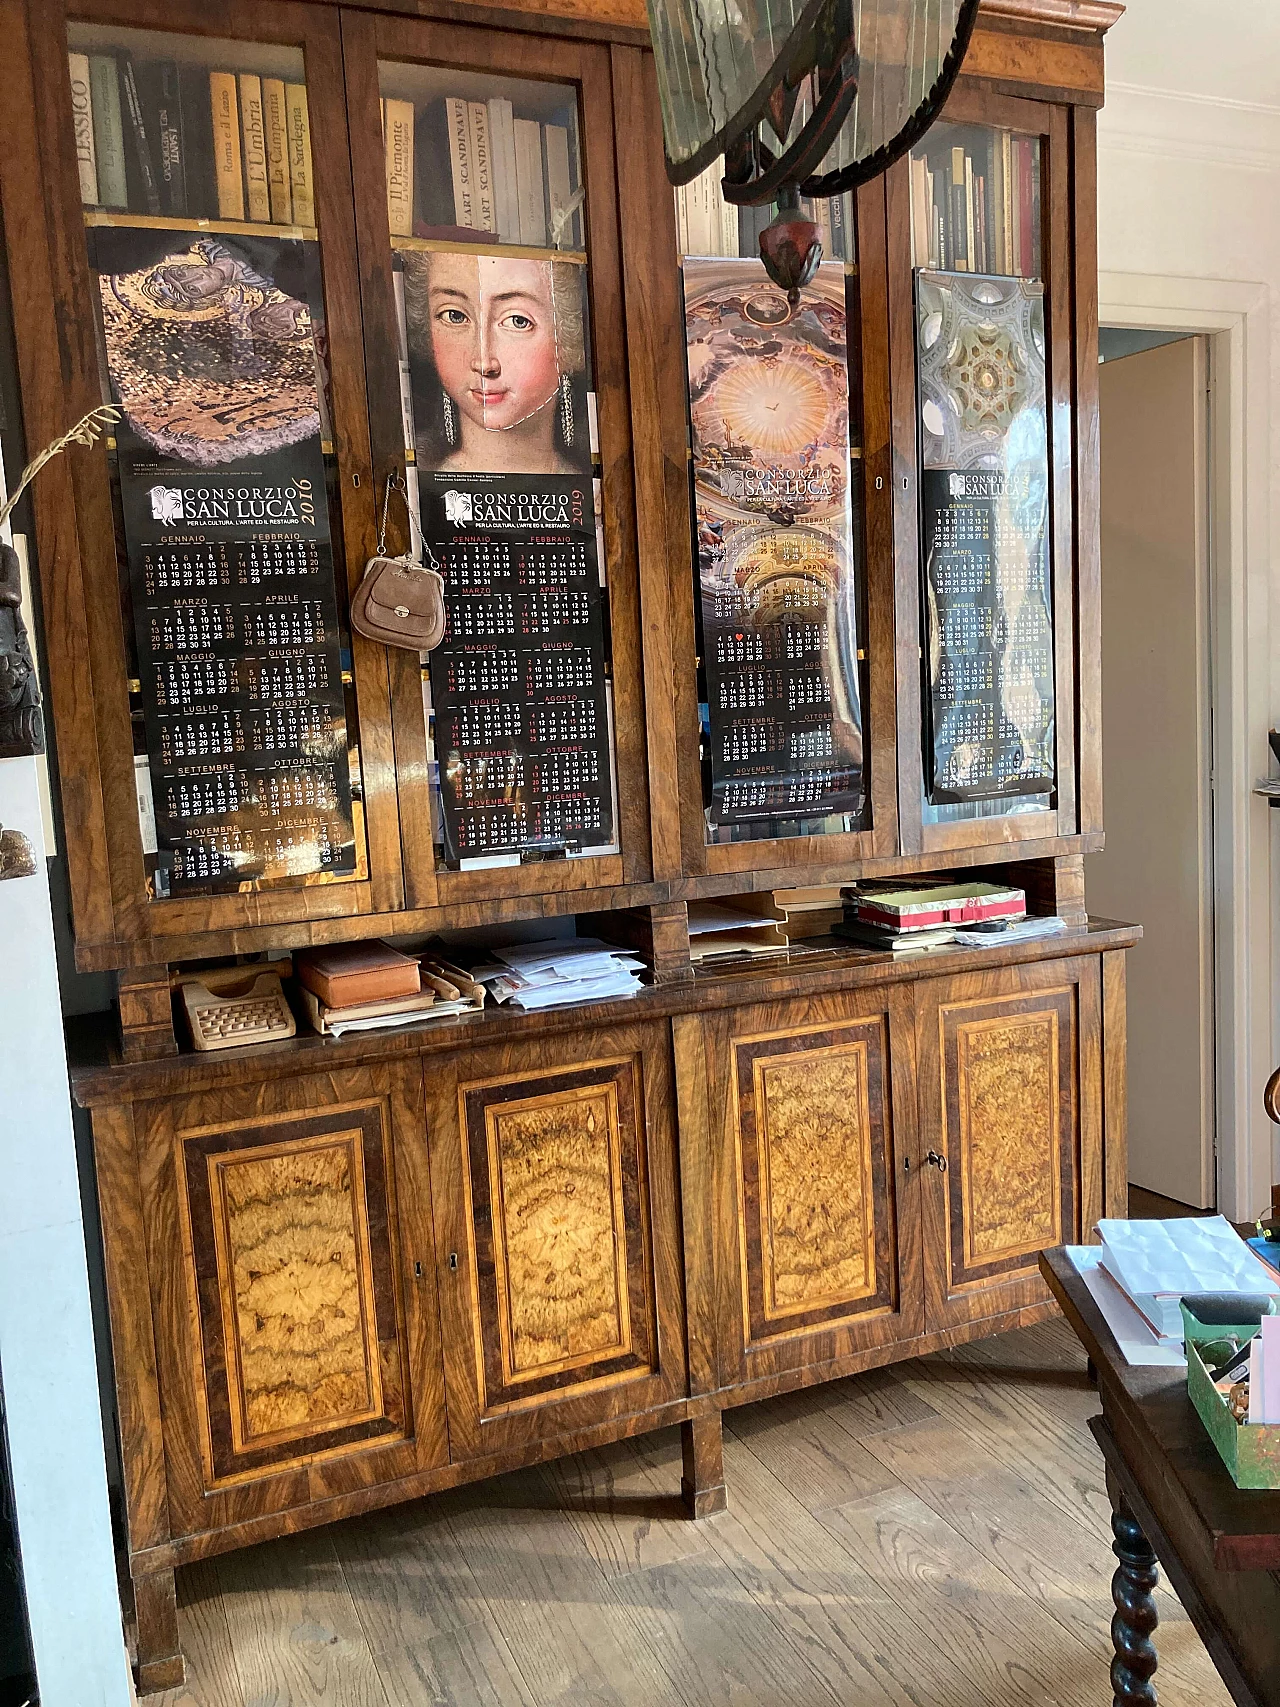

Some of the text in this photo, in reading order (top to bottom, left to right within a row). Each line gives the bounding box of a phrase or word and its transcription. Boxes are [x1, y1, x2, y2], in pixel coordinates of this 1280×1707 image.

[220, 90, 230, 118] Lazio
[71, 80, 92, 163] LESSICO
[220, 122, 231, 130] il
[245, 100, 265, 182] L'Umbria
[267, 93, 284, 185] La Campania
[169, 134, 180, 164] SANTI
[291, 107, 305, 187] La Sardegna
[161, 133, 172, 182] MEDIOEVO
[223, 142, 233, 173] Roma
[390, 120, 403, 201] Il Piemonte
[455, 102, 472, 227] L'ART SCANDINAVE
[475, 109, 491, 232] L'ART SCANDINAVE
[745, 470, 830, 480] CONSORZIO
[966, 475, 1019, 484] CONSORZIO
[184, 487, 297, 500] CONSORZIO
[746, 480, 831, 496] SAN LUCA
[966, 484, 988, 495] SAN
[991, 484, 1019, 495] LUCA
[292, 477, 315, 526] 2016
[473, 494, 569, 505] CONSORZIO
[185, 500, 298, 519] SAN LUCA
[474, 505, 570, 521] SAN LUCA
[572, 489, 584, 525] 2019
[176, 653, 216, 661] MAGGIO
[183, 705, 219, 713] LUGLIO
[272, 699, 310, 707] AGOSTO
[732, 717, 776, 725] SETTEMBRE
[274, 757, 318, 766] OTTOBRE
[178, 764, 235, 774] SETTEMBRE
[468, 798, 513, 807] NOVEMBRE
[546, 792, 587, 800] DICEMBRE
[278, 817, 325, 827] DICEMBRE
[186, 825, 240, 836] NOVEMBRE
